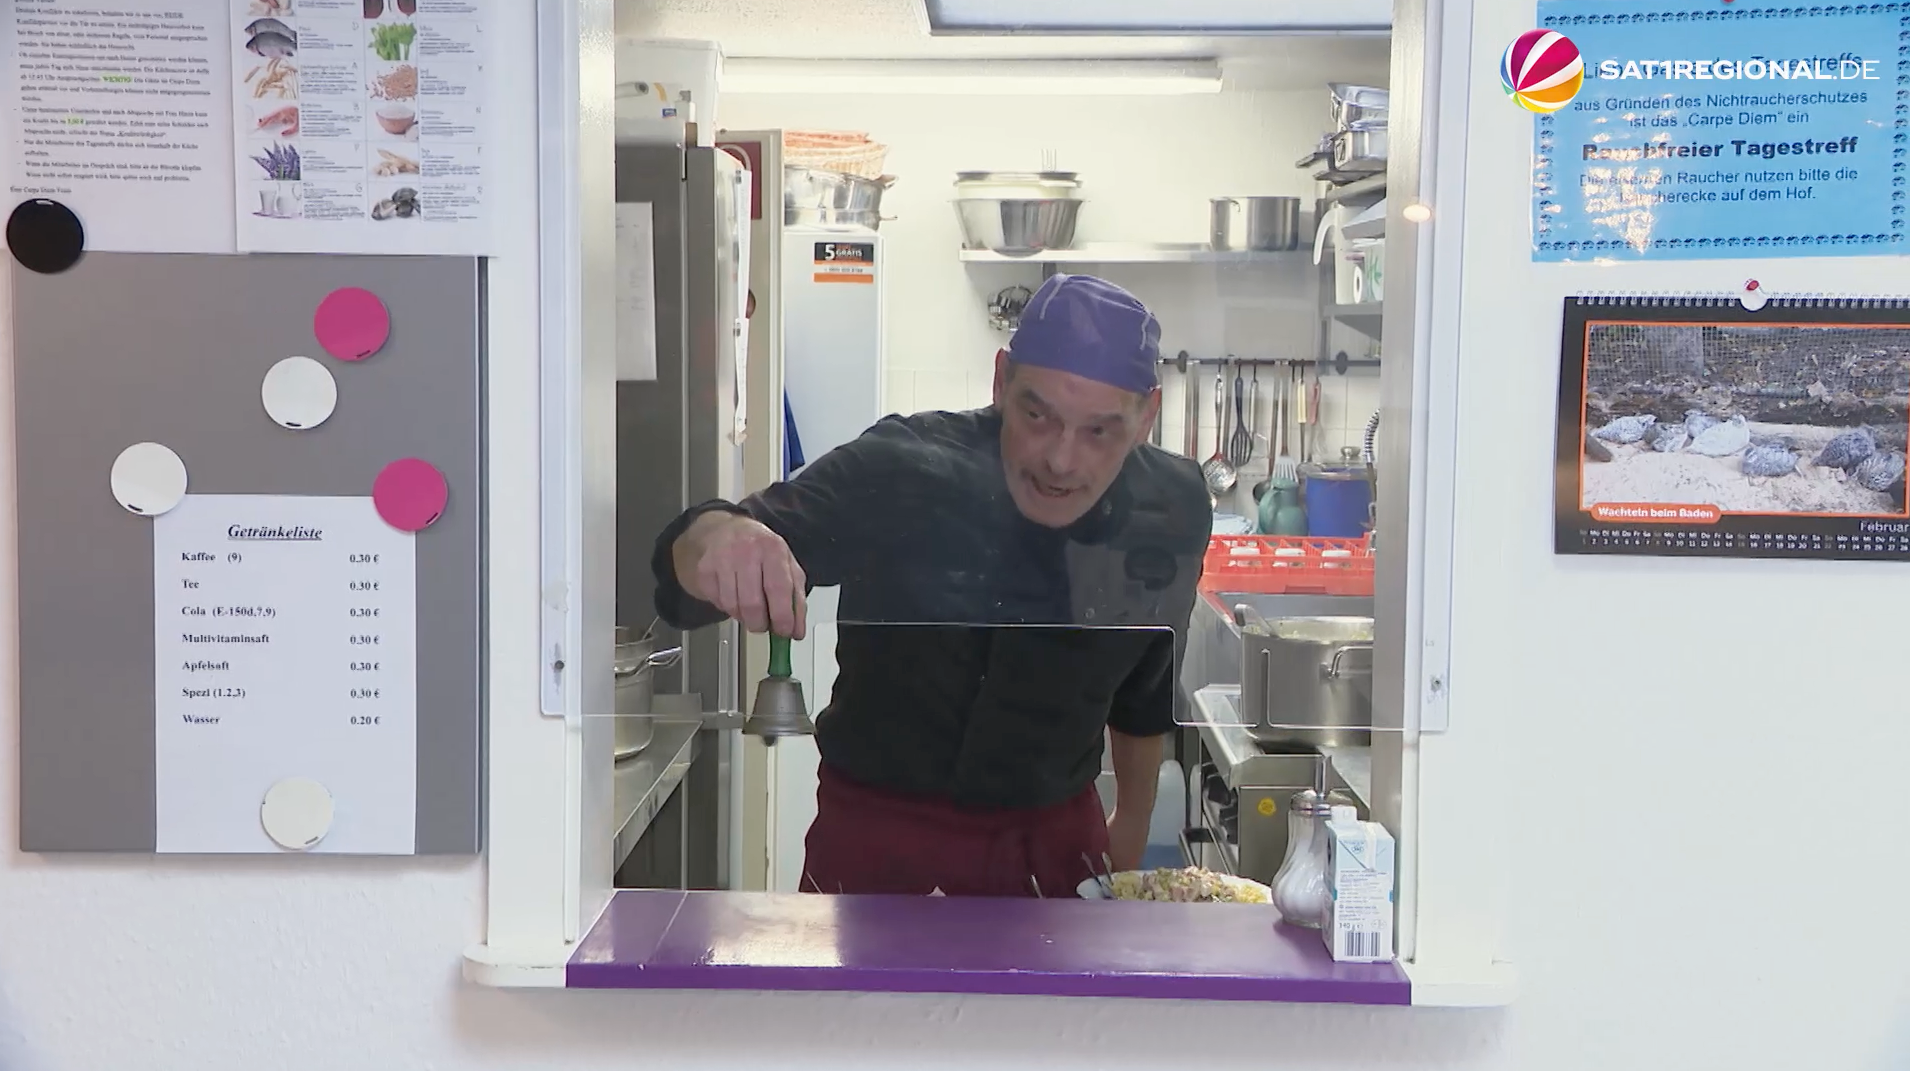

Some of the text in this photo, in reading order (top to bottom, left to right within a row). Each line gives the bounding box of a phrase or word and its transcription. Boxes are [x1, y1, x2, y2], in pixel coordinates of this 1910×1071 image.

[1575, 91, 1868, 111] aus Gründen des Nichtraucherschutzes
[1630, 116, 1646, 127] ist
[1651, 115, 1678, 127] das
[1787, 112, 1809, 124] ein
[1731, 136, 1859, 159] Tagestreff
[1678, 170, 1737, 184] Raucher
[1744, 171, 1794, 182] nutzen
[1799, 168, 1830, 181] bitte
[1835, 167, 1858, 181] die
[1721, 188, 1745, 201] auf
[1749, 187, 1780, 201] dem
[1786, 186, 1816, 199] Hof.
[825, 243, 836, 261] 5
[1598, 507, 1713, 519] Wachteln beim Baden
[228, 524, 323, 540] Getränkeliste
[1860, 521, 1909, 533] Februar
[181, 552, 379, 564] Kaffee (9) 0.30 €
[181, 579, 379, 591] Tee 0.30 €
[181, 607, 206, 616] Cola
[349, 608, 371, 617] 0.30
[373, 608, 379, 617] €
[182, 634, 379, 645] Multivitaminsaft 0.30 €
[182, 661, 380, 671] Apfelsaft 0.30 €
[182, 688, 210, 698] Spezi
[350, 690, 372, 699] 0.30
[374, 690, 380, 699] €
[183, 715, 380, 725] Wasser 0.20 €
